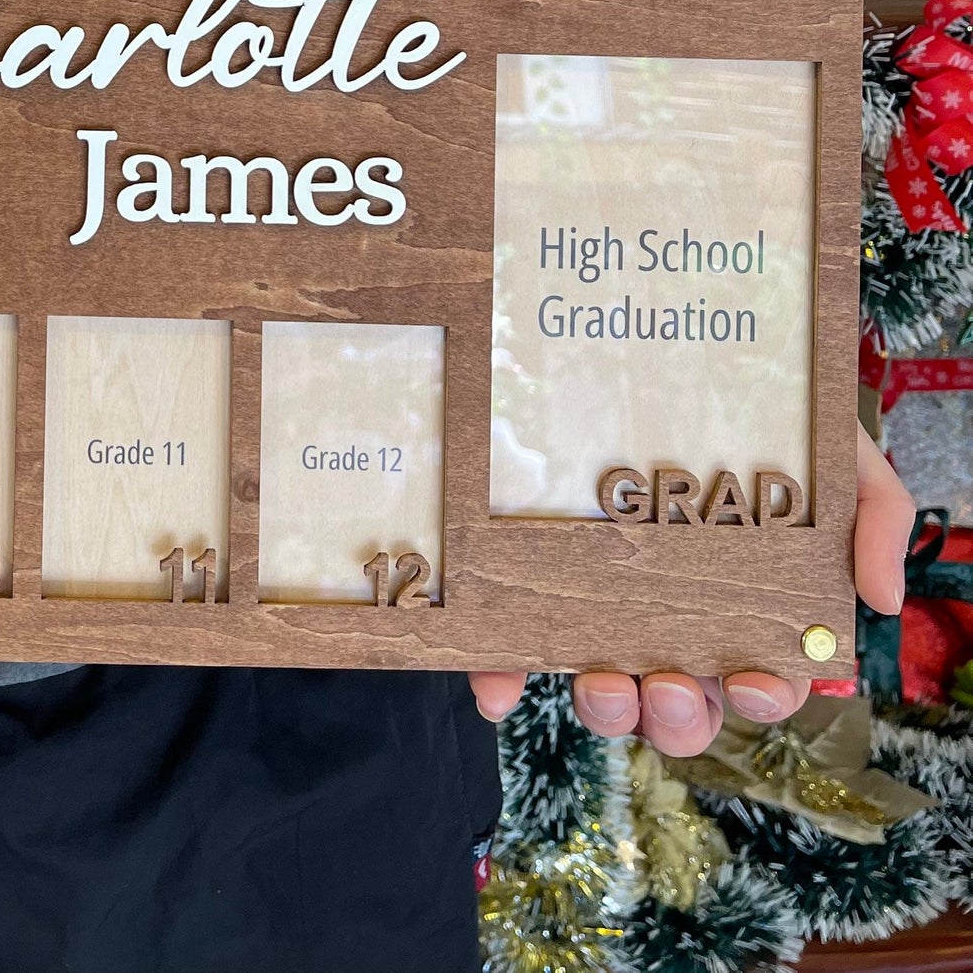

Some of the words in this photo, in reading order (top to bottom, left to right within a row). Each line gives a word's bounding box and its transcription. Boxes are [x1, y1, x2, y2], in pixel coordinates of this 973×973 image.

[69, 130, 407, 245] James
[540, 226, 624, 282] High
[638, 228, 764, 274] School
[538, 294, 756, 342] Graduation
[87, 439, 155, 465] Grade
[162, 442, 186, 466] 11
[301, 445, 369, 471] Grade
[377, 447, 402, 471] 12
[598, 467, 804, 527] GRAD
[159, 547, 216, 603] 11
[363, 552, 431, 606] 12
